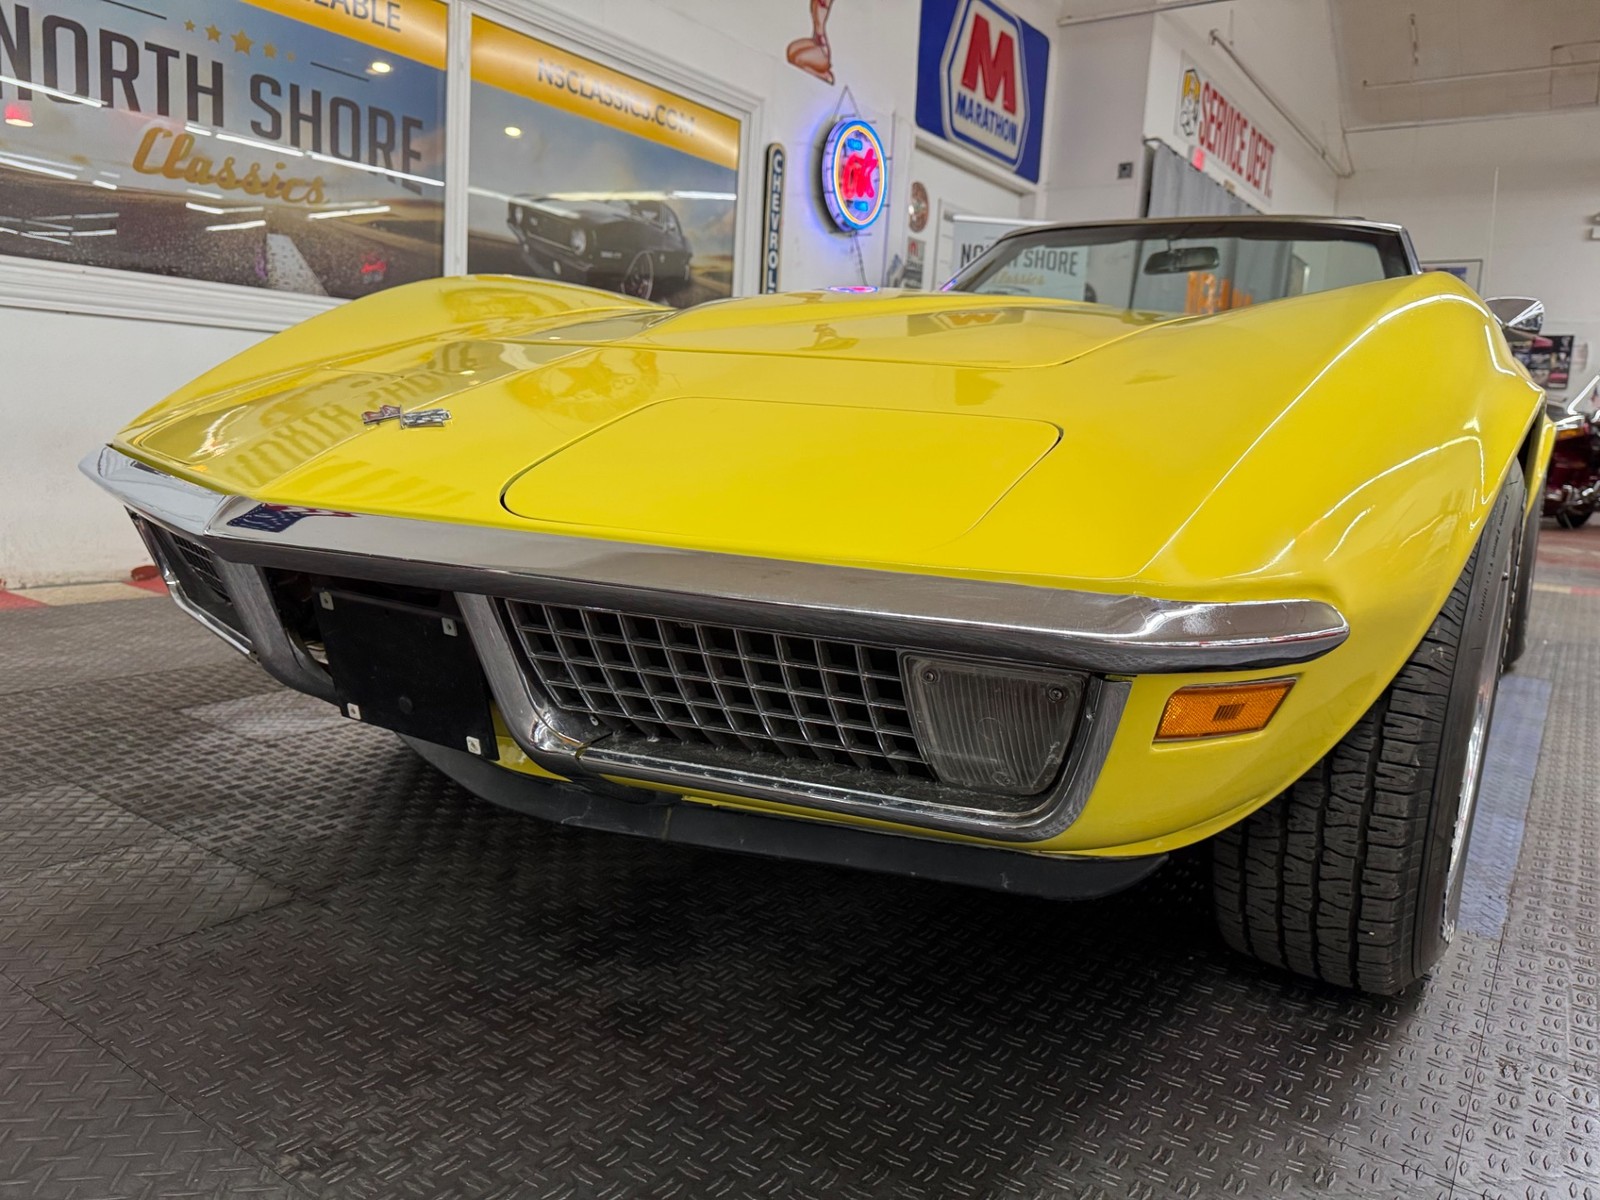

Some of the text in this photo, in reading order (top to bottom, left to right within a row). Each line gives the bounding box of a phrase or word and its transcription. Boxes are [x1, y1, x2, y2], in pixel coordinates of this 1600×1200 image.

[0, 3, 424, 195] NORTH SHORE
[537, 58, 697, 136] NSCLASSICS.COM
[961, 13, 1017, 115] M
[955, 91, 1019, 146] MARATHON
[1199, 81, 1248, 176] SERVICE
[133, 126, 328, 205] Classics
[1023, 249, 1079, 277] SHORE
